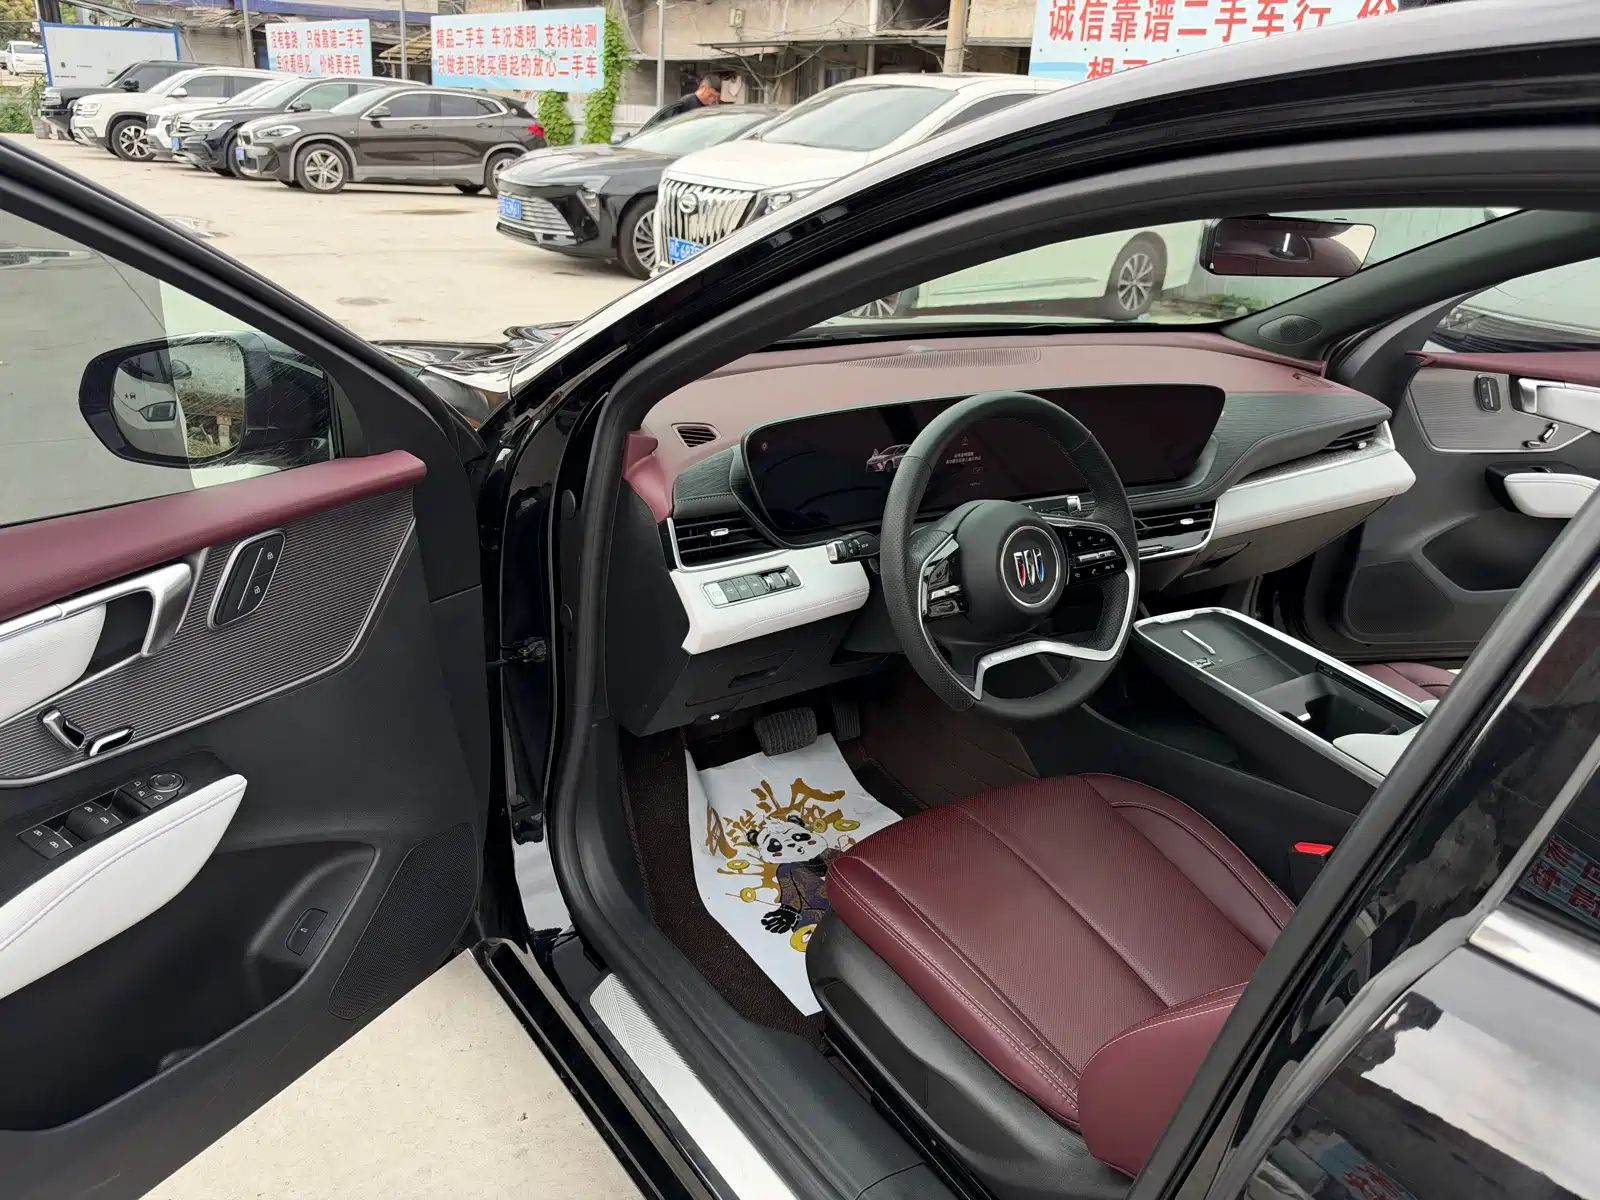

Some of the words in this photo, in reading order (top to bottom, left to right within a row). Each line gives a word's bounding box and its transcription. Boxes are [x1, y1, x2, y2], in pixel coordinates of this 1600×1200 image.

[436, 27, 485, 48] 精品二手车
[492, 25, 537, 48] 车况透明
[544, 23, 598, 48] 支持检测
[437, 54, 599, 79] 只做老百姓买得起的放心二手车
